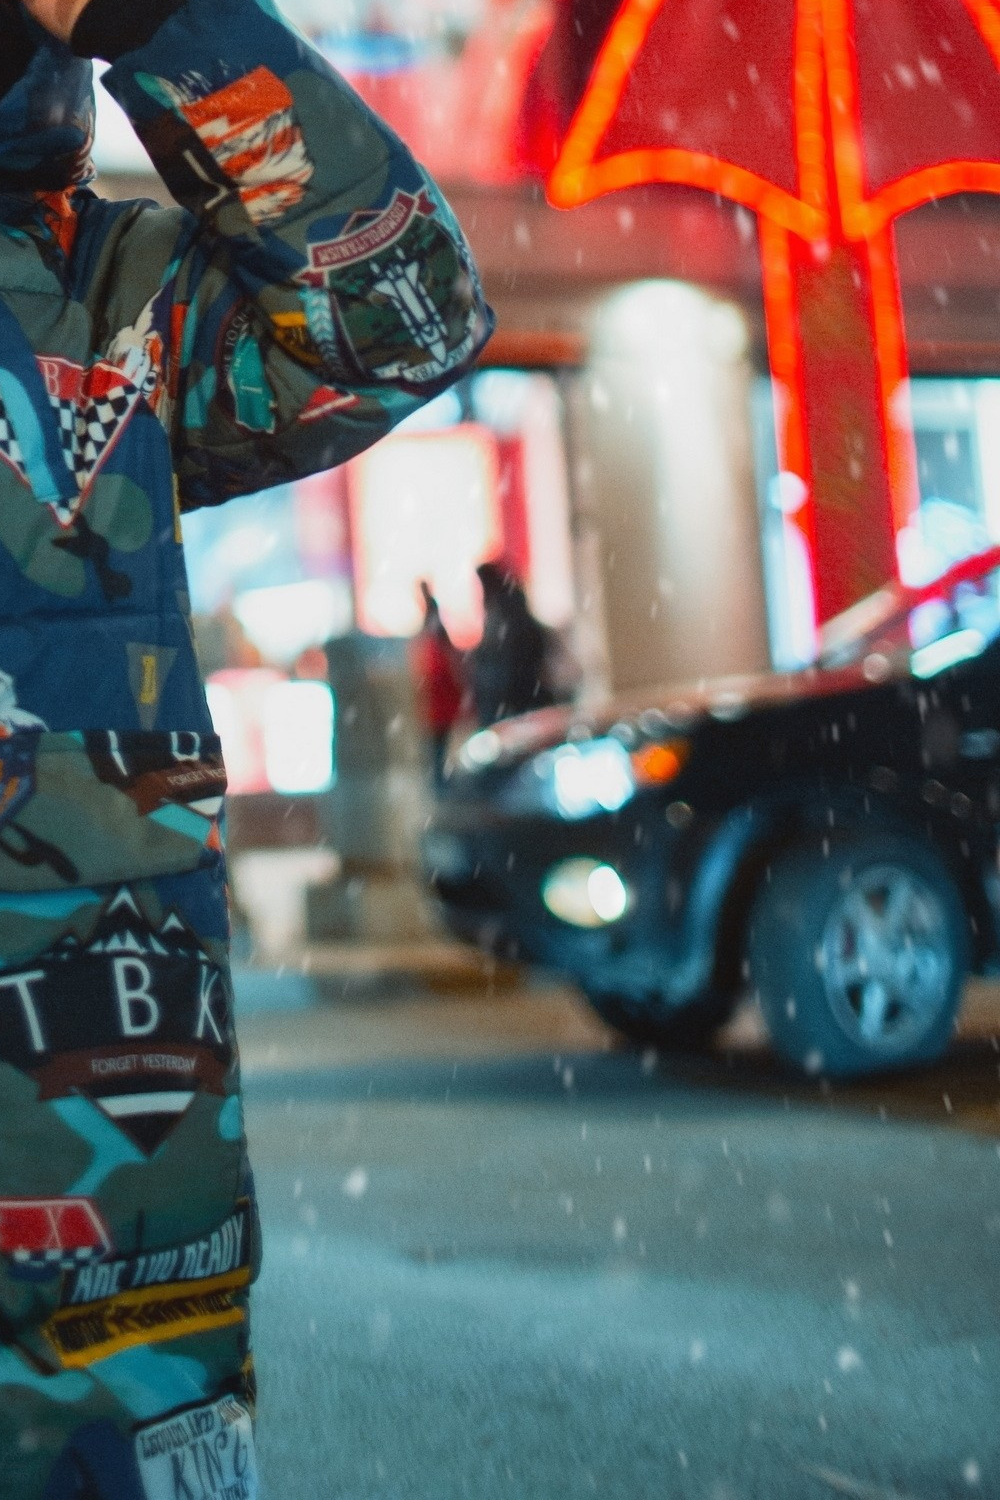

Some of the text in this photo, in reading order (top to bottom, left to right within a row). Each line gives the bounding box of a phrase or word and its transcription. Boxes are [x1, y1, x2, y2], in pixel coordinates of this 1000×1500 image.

[317, 200, 408, 264] COSMOPOLITANISM
[91, 1053, 197, 1075] FORGET YESTERDAY
